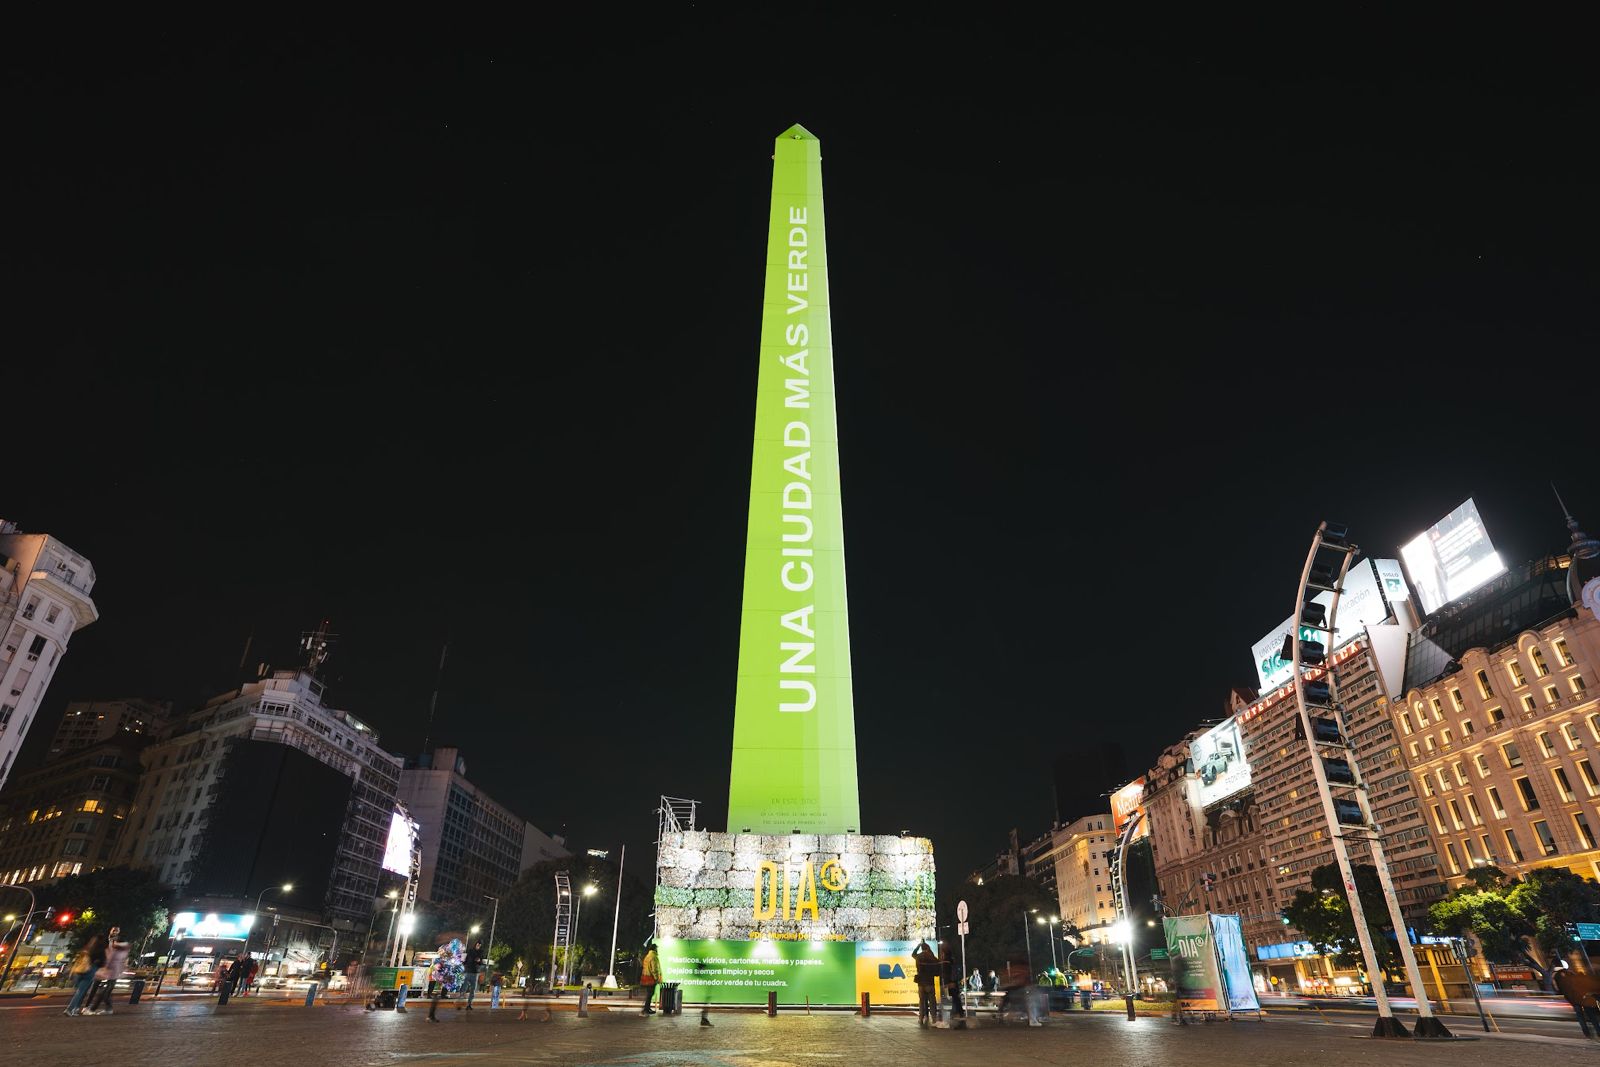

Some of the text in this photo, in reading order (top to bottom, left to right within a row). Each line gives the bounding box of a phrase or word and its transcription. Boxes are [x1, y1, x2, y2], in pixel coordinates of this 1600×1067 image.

[778, 206, 817, 713] UNA CIUDAD MÁS VERDE
[1237, 642, 1360, 725] HOTEL REUBICA
